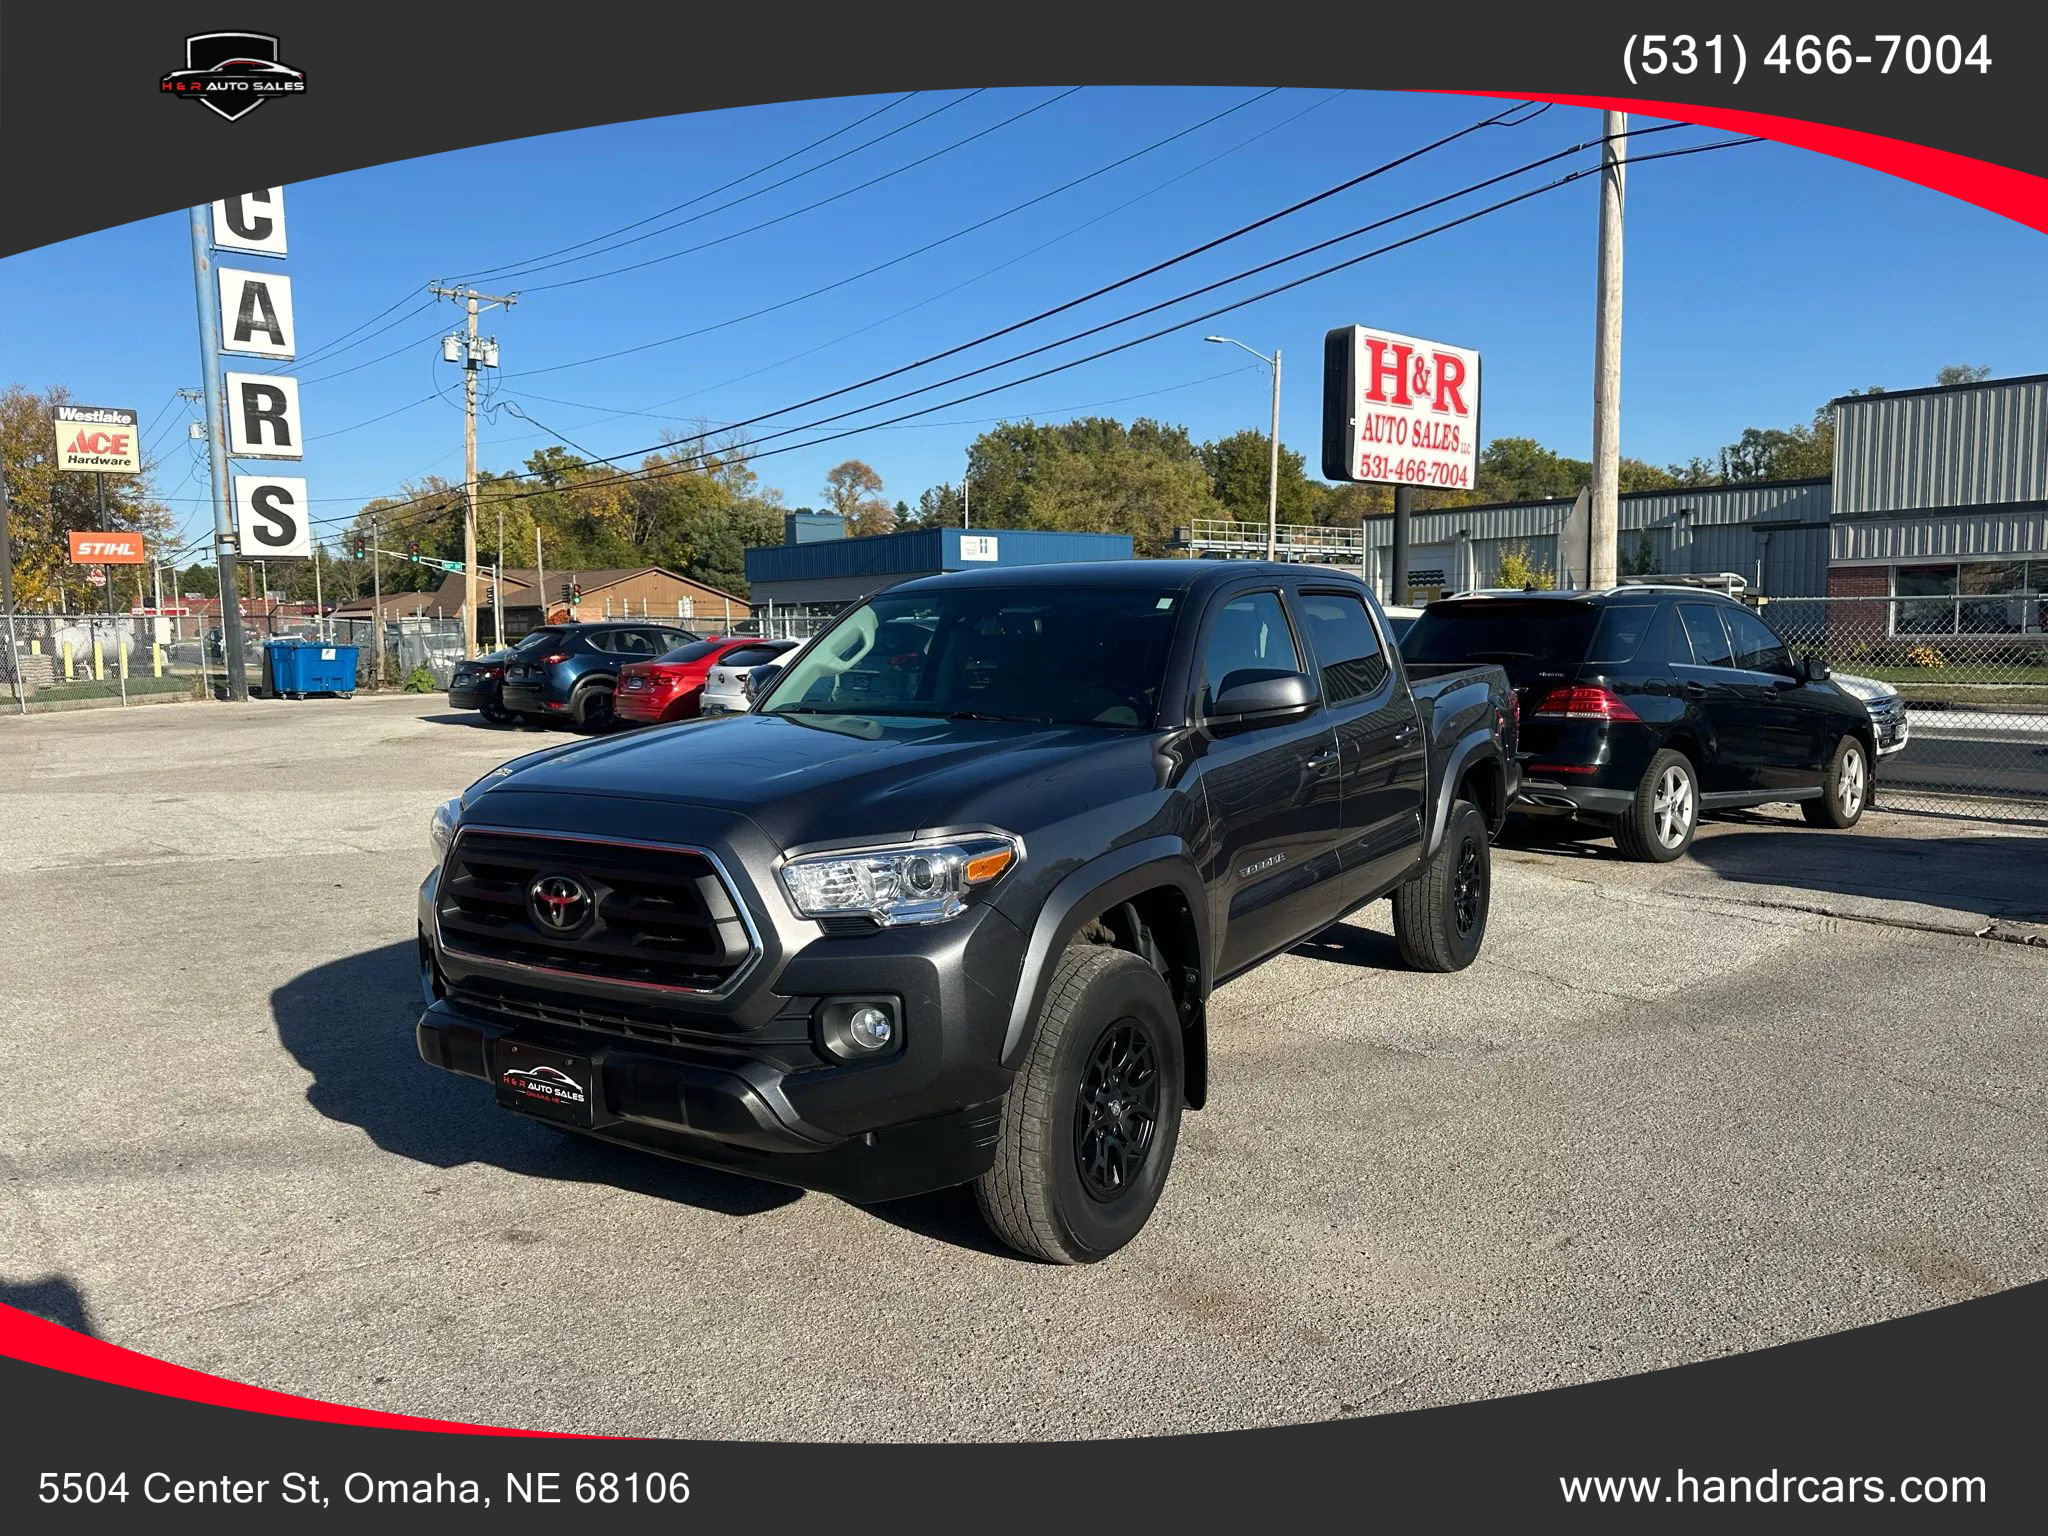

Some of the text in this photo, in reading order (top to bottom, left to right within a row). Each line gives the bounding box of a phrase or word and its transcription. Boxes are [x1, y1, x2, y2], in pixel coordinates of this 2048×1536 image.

[58, 407, 132, 424] Westlake
[66, 428, 130, 456] ACE
[1361, 412, 1409, 446] AUTO
[1411, 418, 1461, 453] SALES
[67, 454, 132, 467] Hardware
[1359, 452, 1469, 487] 531-466-7004
[76, 542, 137, 557] STIHL
[527, 1082, 553, 1094] AUTO
[554, 1088, 585, 1103] SALES
